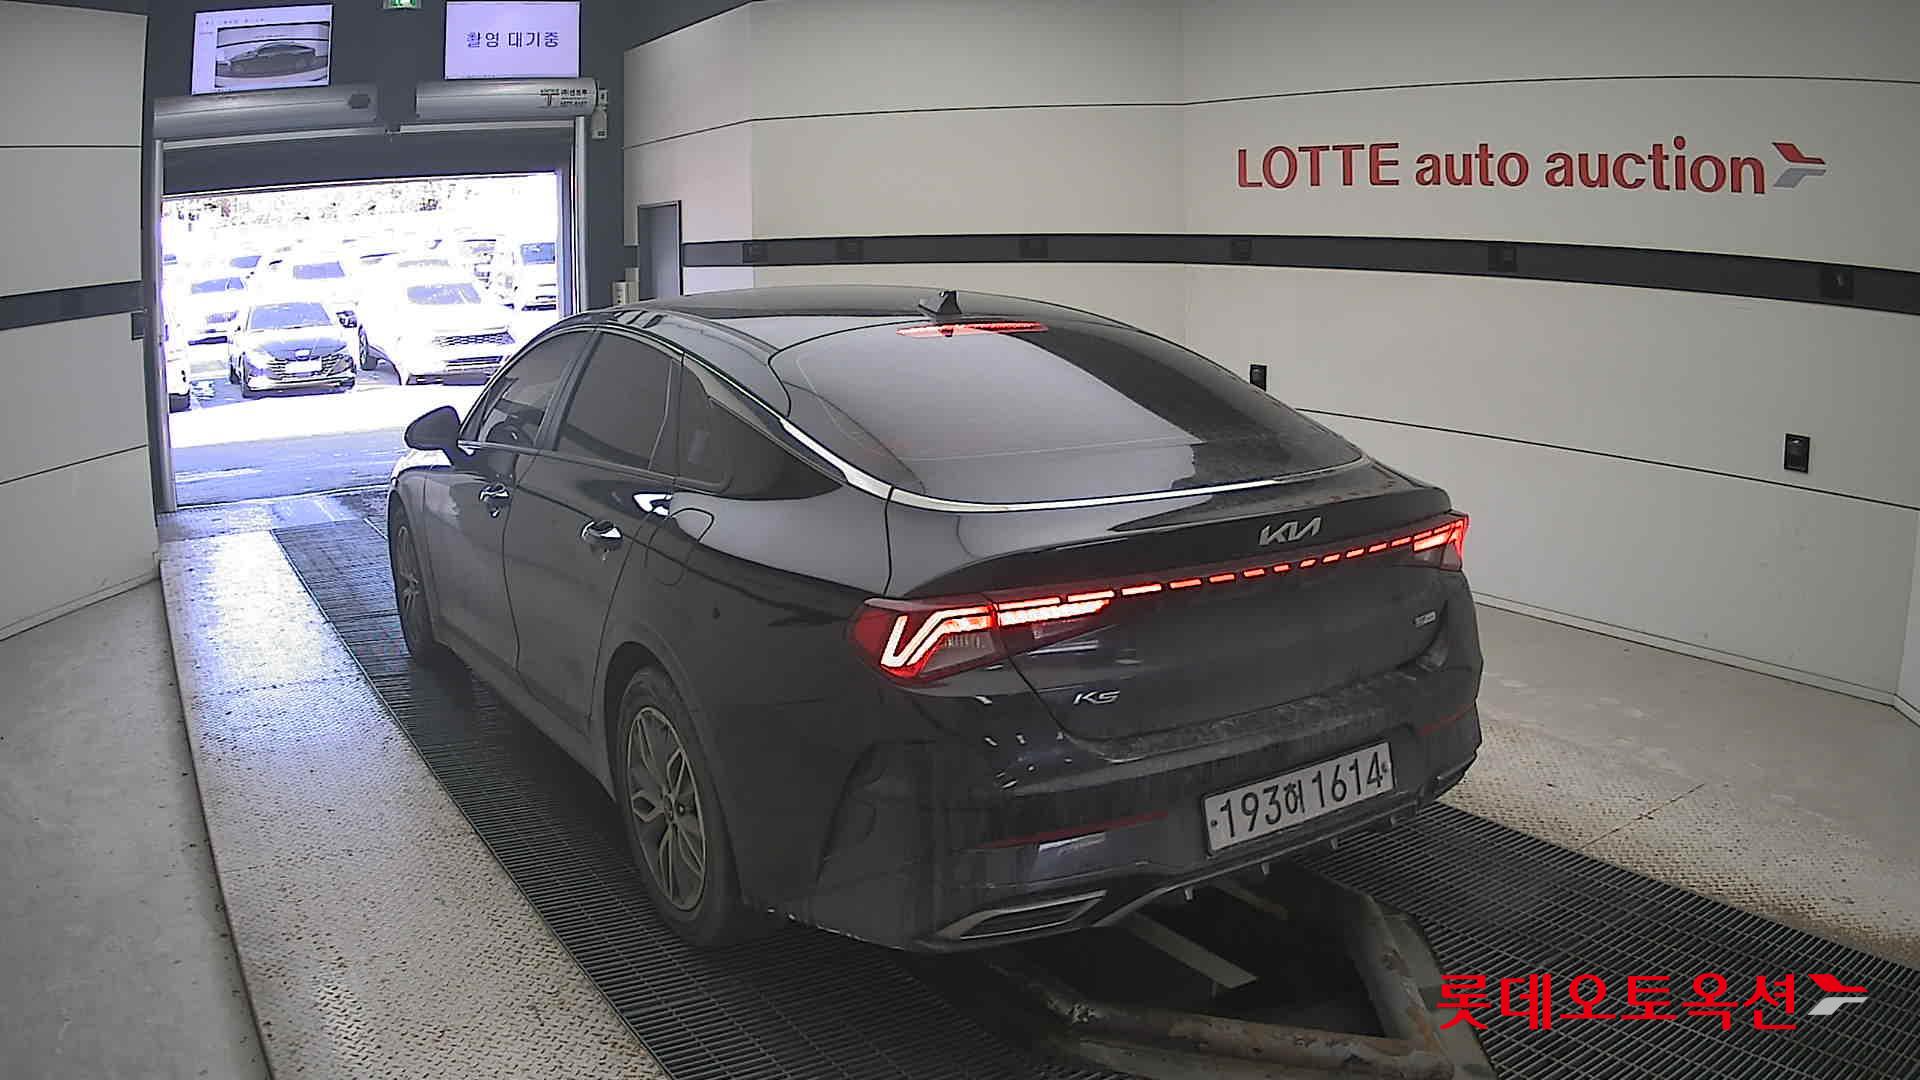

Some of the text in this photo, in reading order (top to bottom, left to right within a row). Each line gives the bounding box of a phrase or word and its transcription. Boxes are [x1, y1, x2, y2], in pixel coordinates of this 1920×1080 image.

[508, 31, 560, 48] 대기중
[1237, 136, 1766, 194] LOTTE auto auction
[1259, 516, 1323, 546] KIA
[1073, 690, 1121, 705] K5
[1219, 751, 1385, 839] 193허 1614
